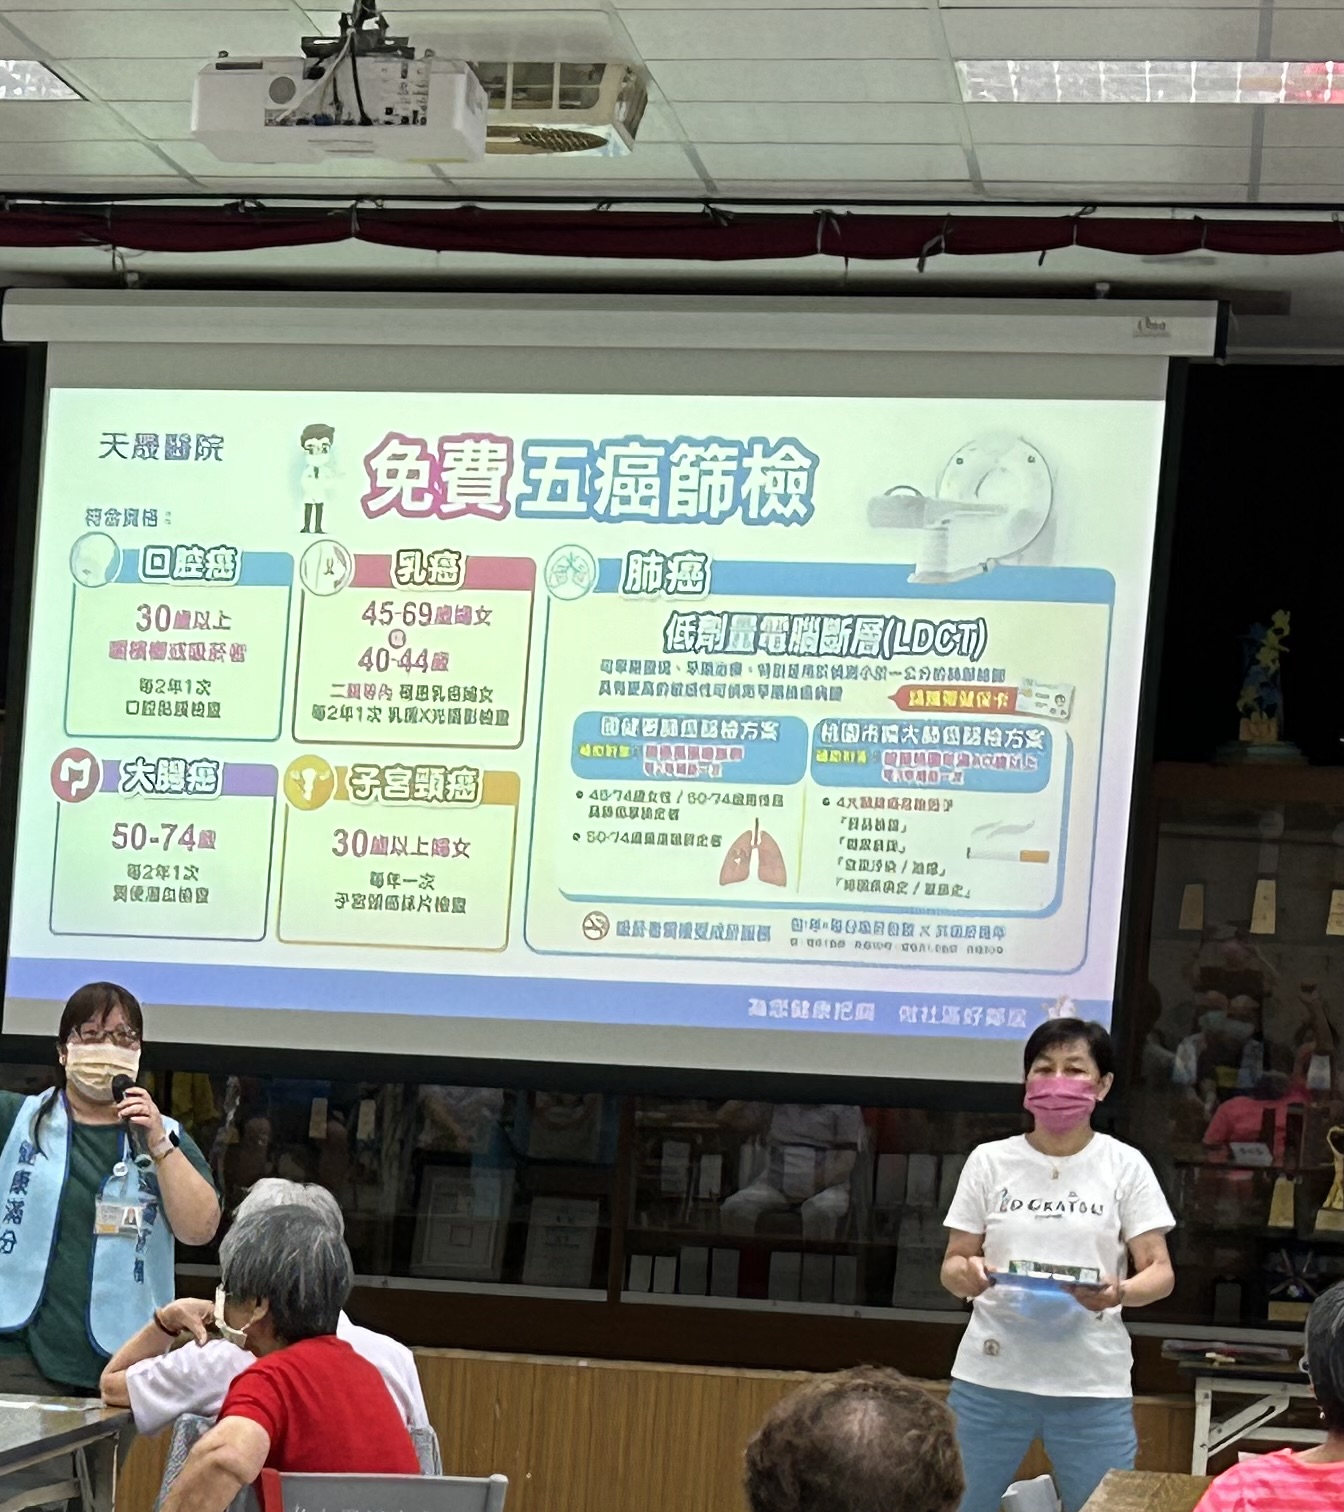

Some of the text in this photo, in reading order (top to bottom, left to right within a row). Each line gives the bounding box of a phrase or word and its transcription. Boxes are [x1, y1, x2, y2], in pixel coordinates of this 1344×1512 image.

[98, 432, 225, 463] 天晟醫院
[361, 431, 820, 526] 免費五癌篩檢
[141, 544, 241, 583] 口腔癌
[391, 549, 464, 588] 乳癌
[621, 550, 711, 596] 肺癌
[663, 611, 987, 661] 低劑量電腦斷層(LDCT)
[121, 757, 220, 797] 大腸癌
[351, 763, 482, 804] 子宮頸癌
